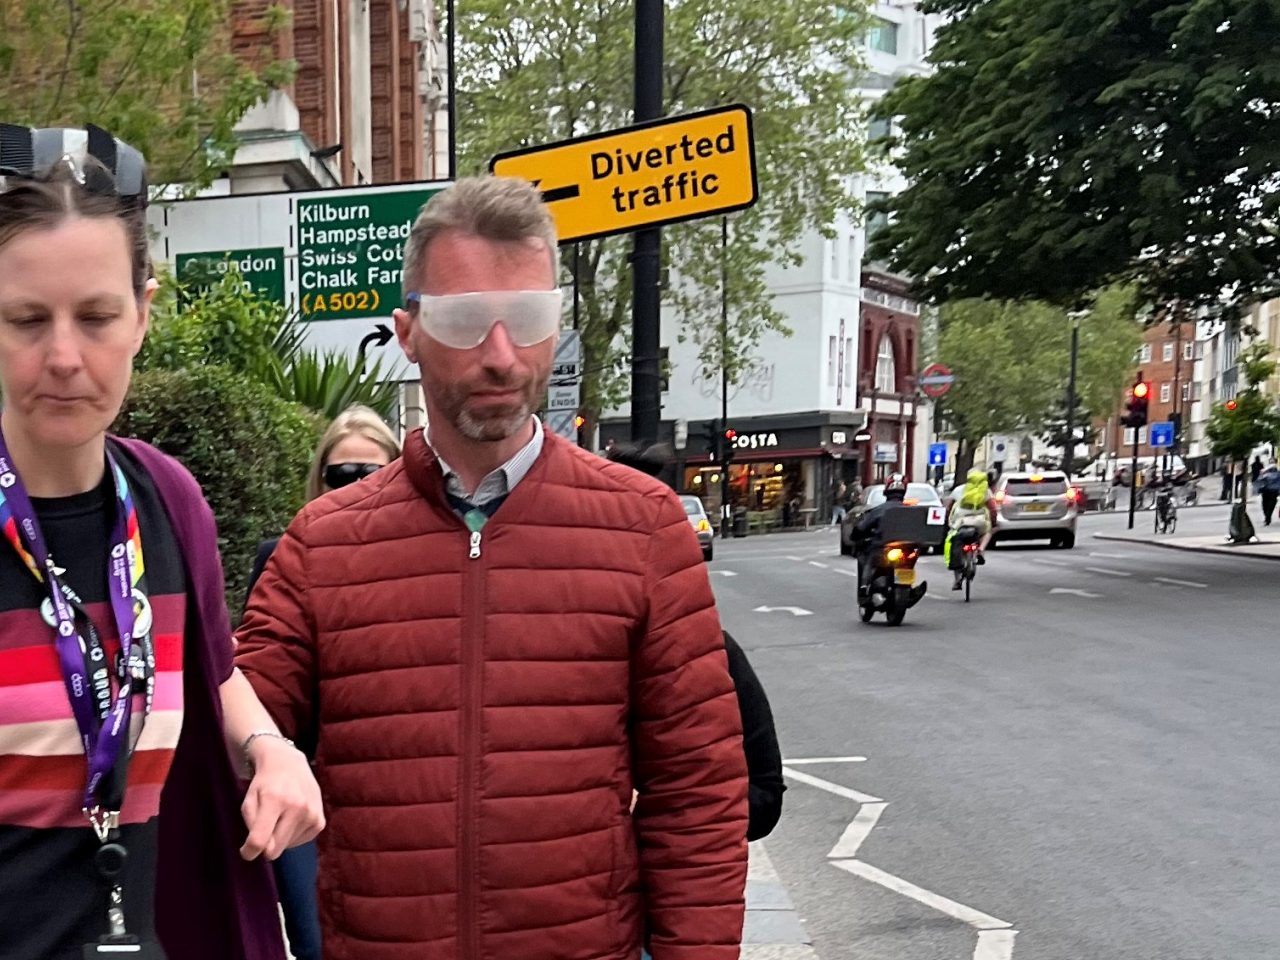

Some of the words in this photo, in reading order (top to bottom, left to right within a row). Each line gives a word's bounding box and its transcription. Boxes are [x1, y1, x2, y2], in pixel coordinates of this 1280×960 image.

[591, 124, 735, 180] Diverted
[612, 170, 719, 213] traffic
[300, 204, 371, 223] Kilburn
[300, 221, 412, 246] Hampstead
[302, 250, 357, 268] Swiss
[367, 244, 404, 262] Cot
[302, 271, 358, 290] Chalk
[368, 266, 404, 285] Far
[302, 290, 380, 315] (A502)
[932, 510, 941, 521] L
